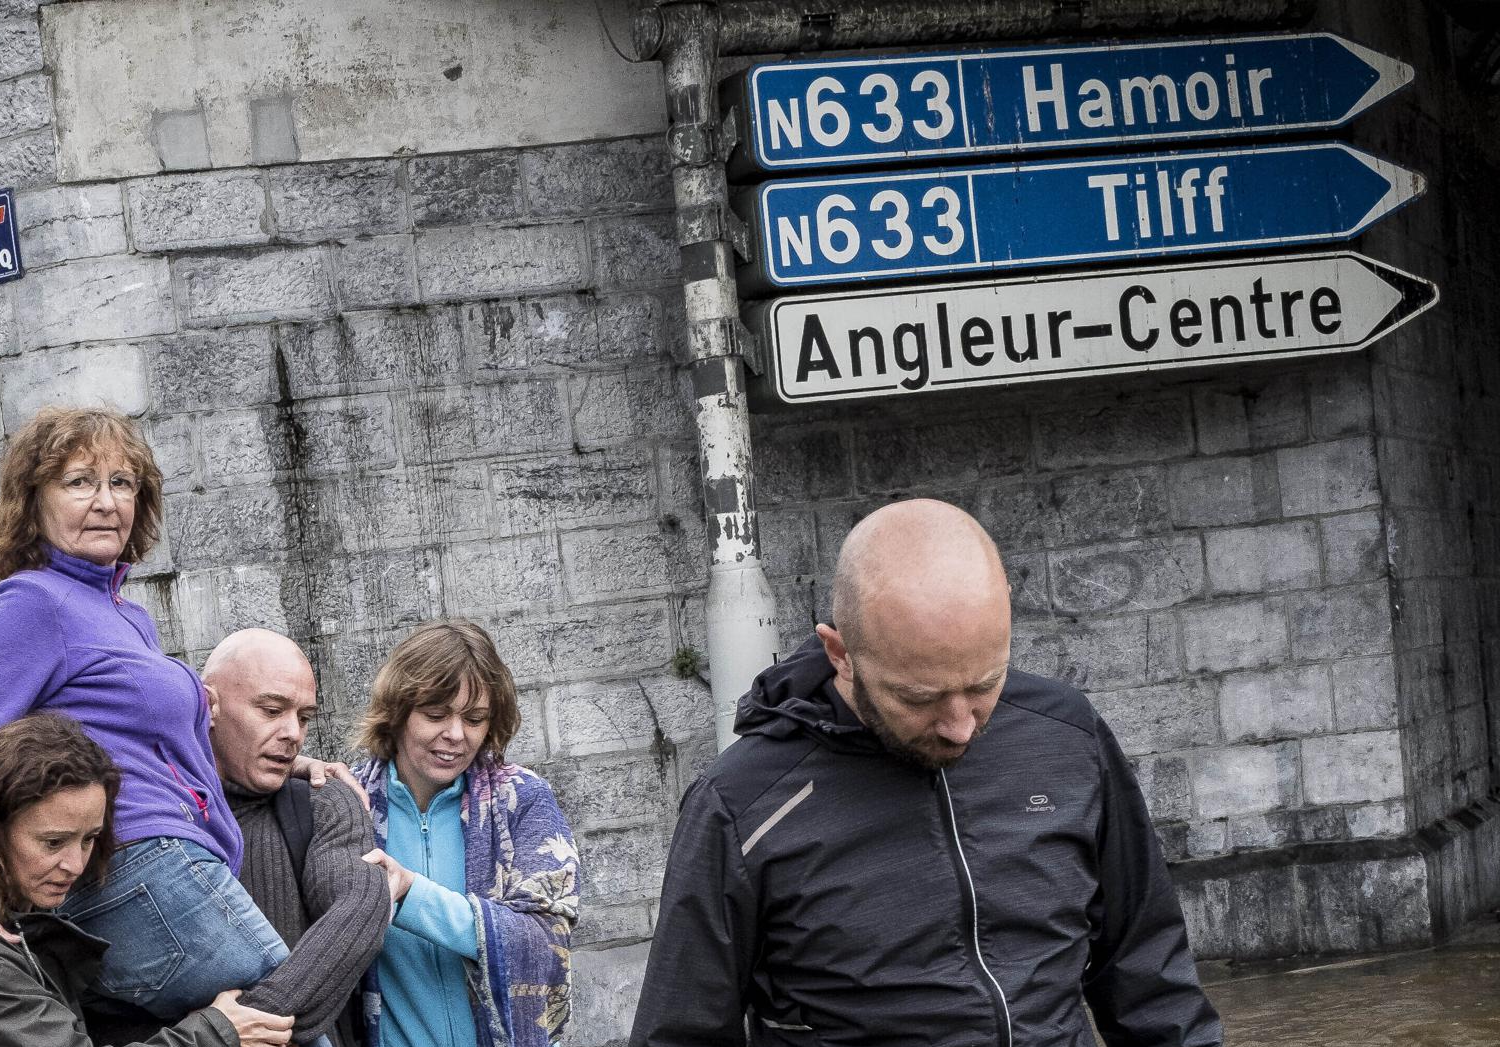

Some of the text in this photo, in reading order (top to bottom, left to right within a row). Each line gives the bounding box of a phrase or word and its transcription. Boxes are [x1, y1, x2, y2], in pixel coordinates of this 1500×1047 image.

[768, 54, 1272, 149] N633 Hamoir
[778, 166, 1228, 266] N633 Tilff
[795, 277, 1342, 390] Angleur-Centre
